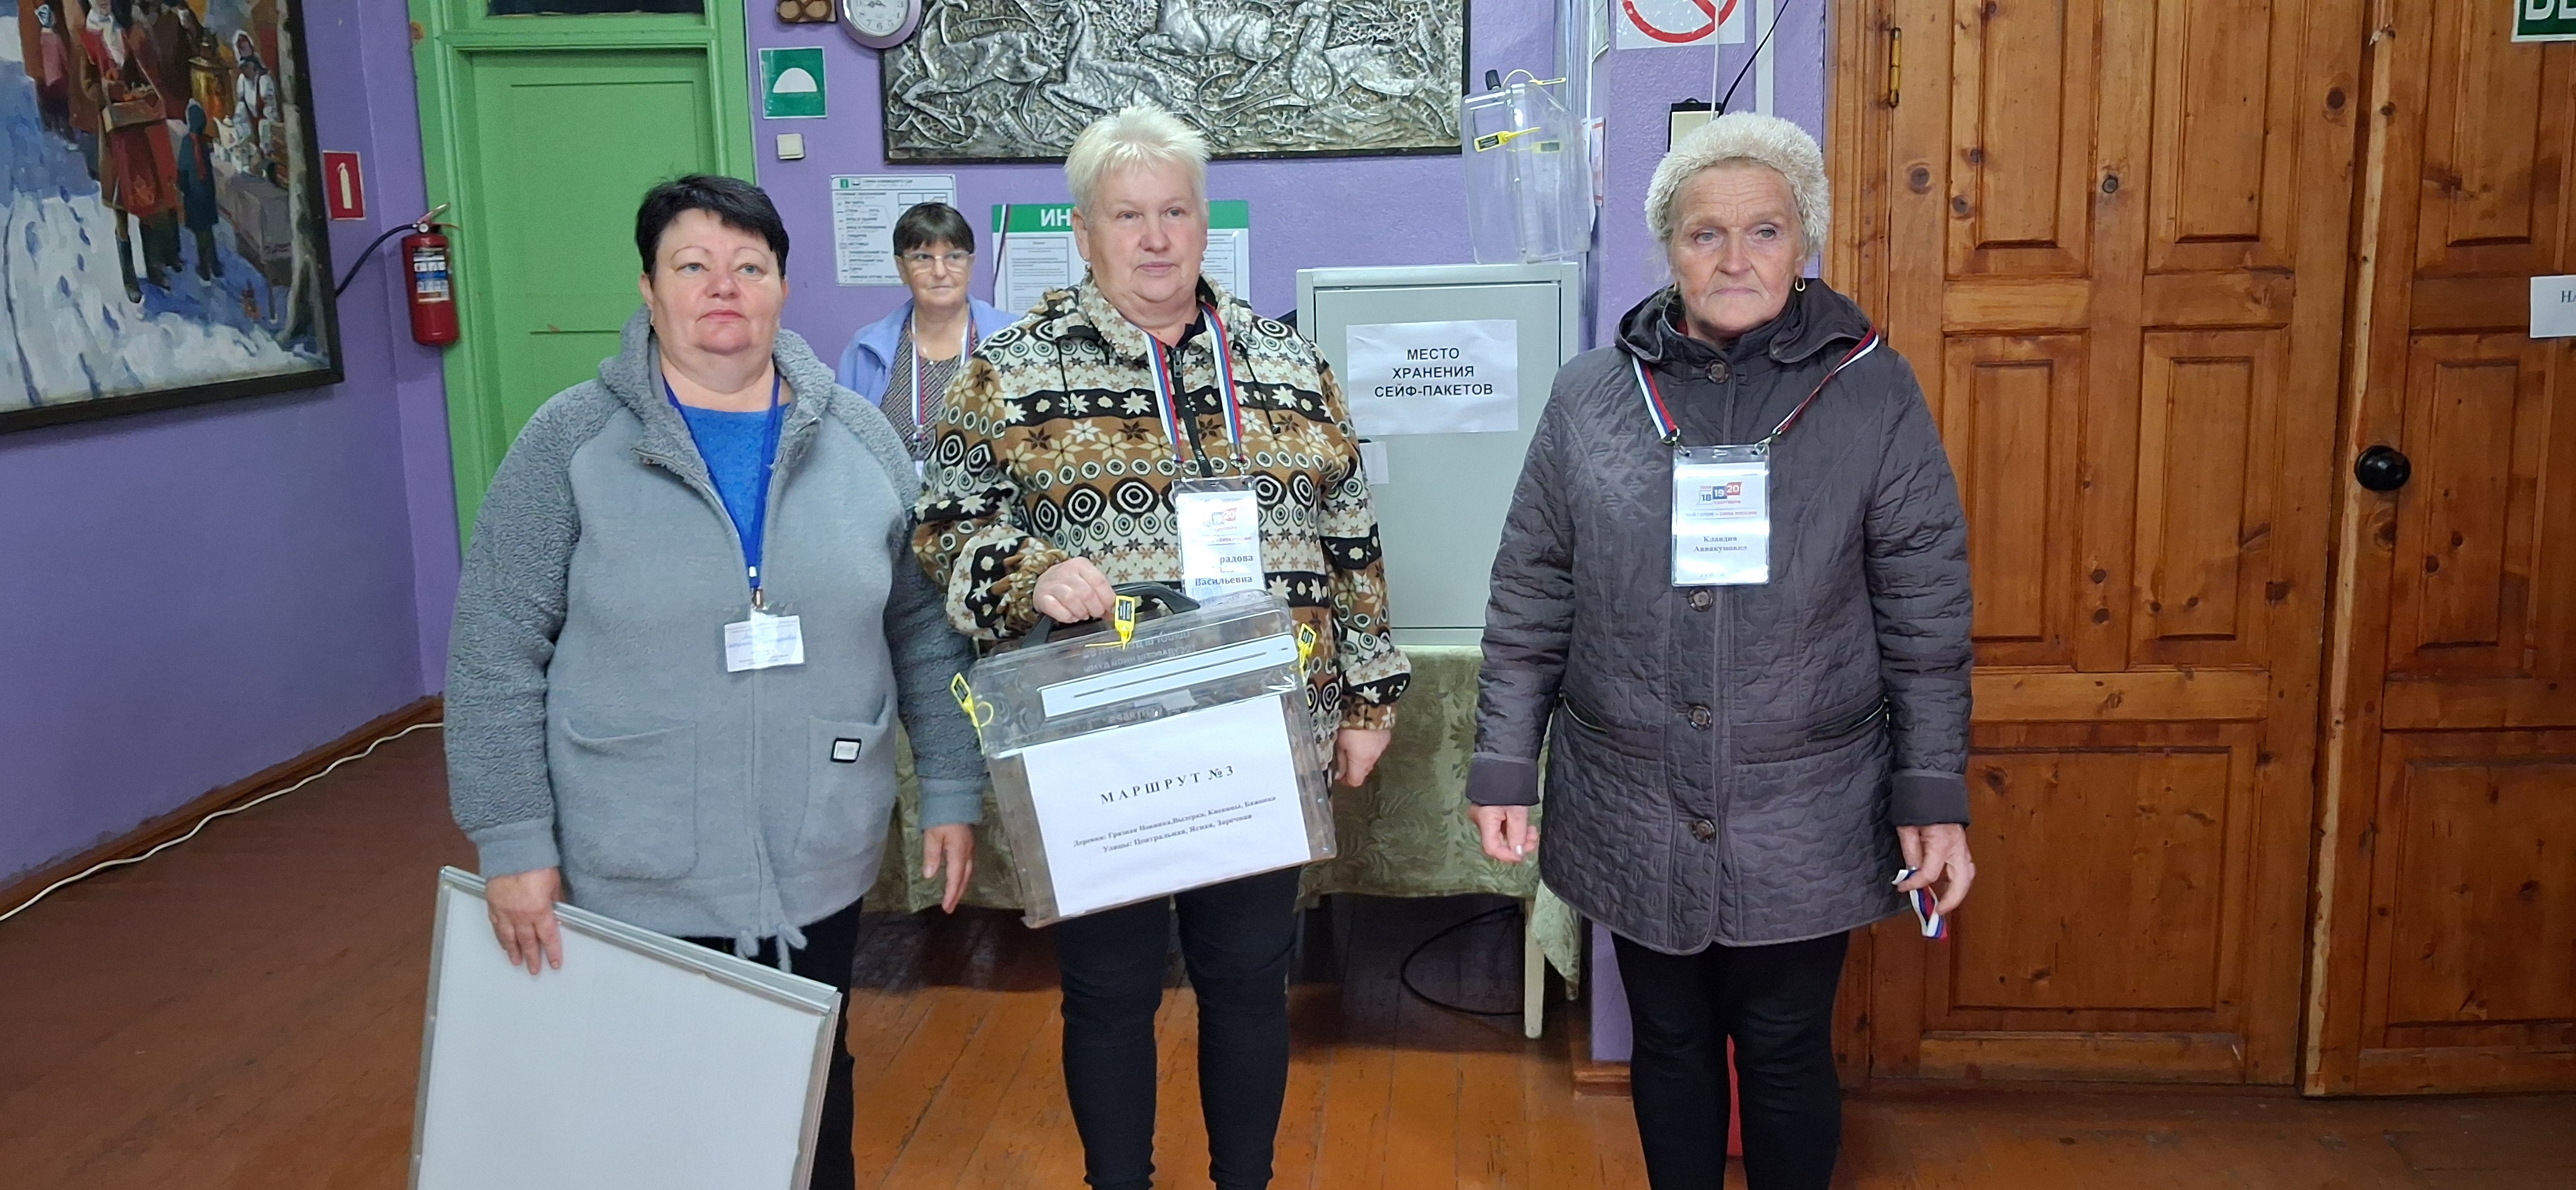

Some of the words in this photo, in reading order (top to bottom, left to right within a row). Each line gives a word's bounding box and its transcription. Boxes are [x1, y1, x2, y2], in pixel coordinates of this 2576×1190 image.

[1041, 208, 1071, 227] ИН
[1407, 347, 1460, 361] МЕСТО
[1392, 366, 1474, 379] ХРАНЕНИЯ
[1374, 383, 1493, 397] СЕЙФ-ПАКЕТОВ
[1714, 489, 1724, 497] 19
[1727, 484, 1739, 493] 20
[1219, 555, 1253, 565] радова
[1195, 575, 1253, 587] Васильевна
[1100, 772, 1200, 805] МАРШРУТ
